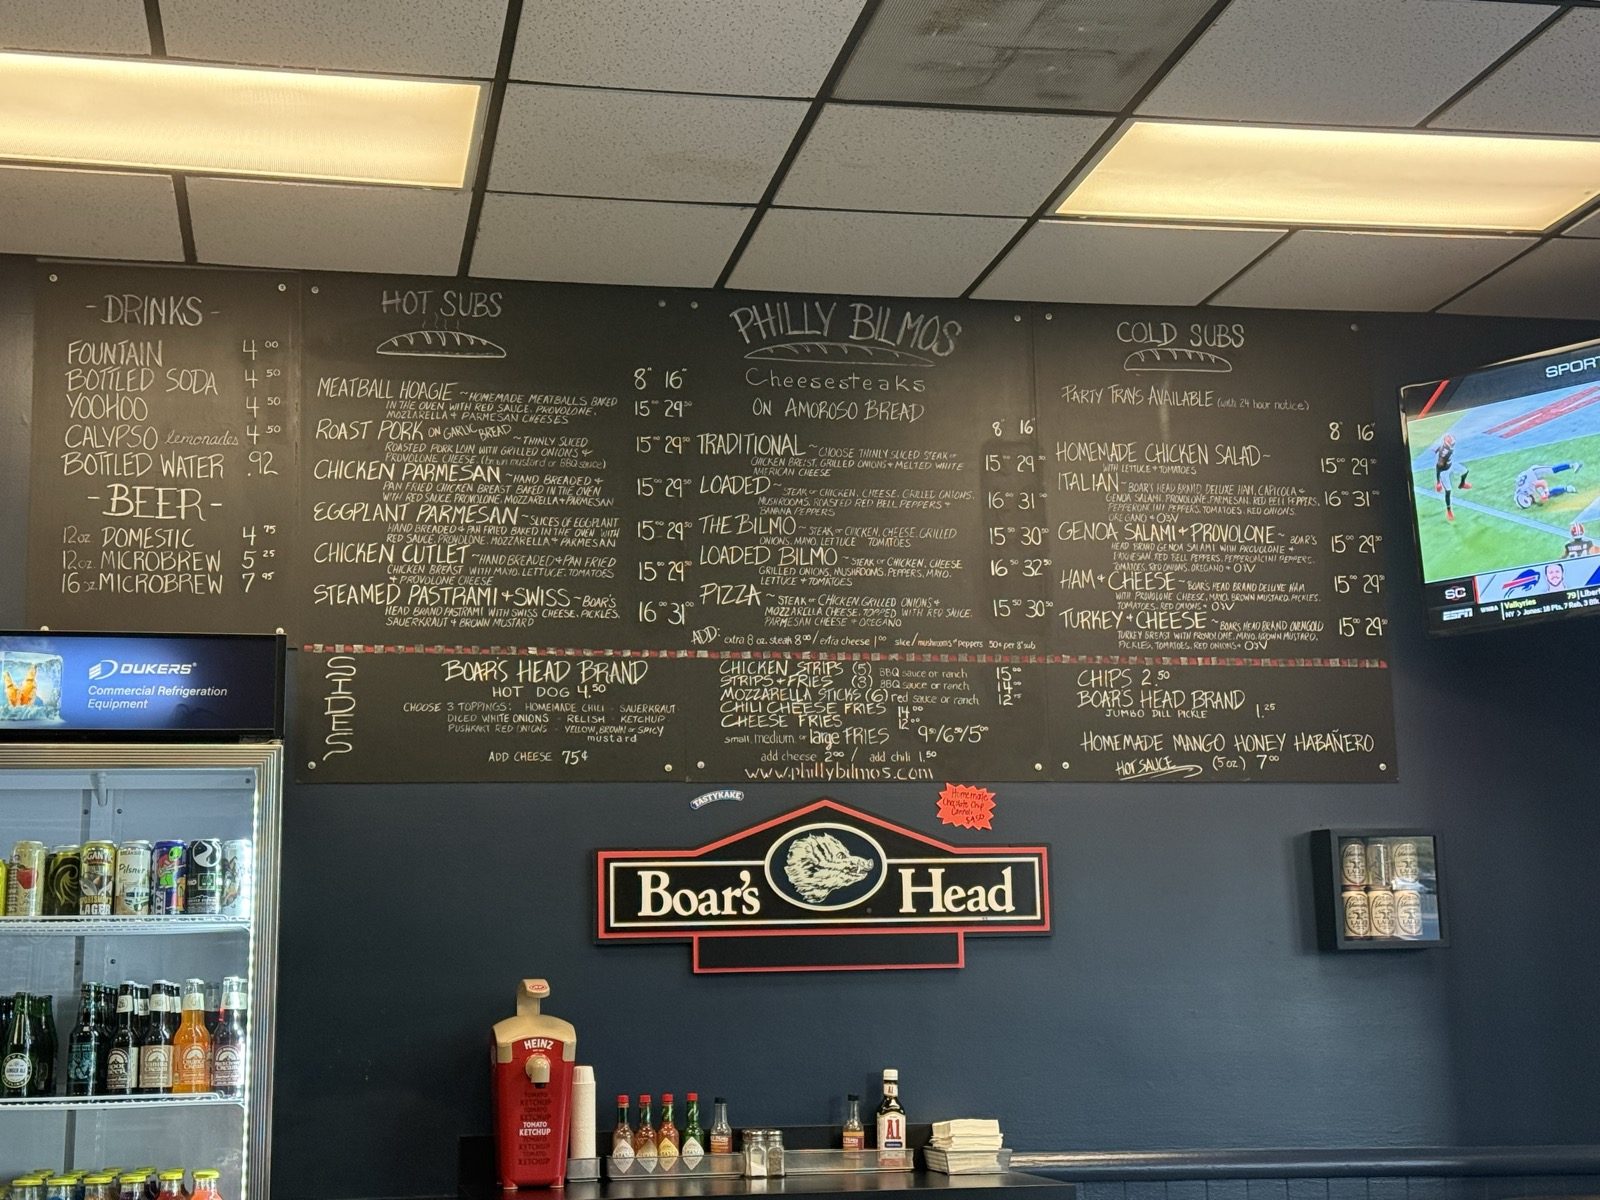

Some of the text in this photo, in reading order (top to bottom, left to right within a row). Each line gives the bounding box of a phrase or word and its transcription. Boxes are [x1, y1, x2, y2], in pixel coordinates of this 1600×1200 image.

[381, 290, 502, 318] HOT SUBS
[729, 301, 962, 357] PHILLY BILMOS
[1116, 321, 1245, 348] COLD SUBS
[67, 339, 162, 368] FOUNTAIN
[64, 367, 219, 396] BOTTLED SODA
[745, 367, 927, 393] Cheesesteaks
[317, 376, 588, 407] MEATBALL HOAGIE HOMEMADE MEATBALLS
[1061, 383, 1103, 406] PARTY
[1107, 385, 1144, 406] TRAYS
[1147, 385, 1214, 408] AVAILABLE
[1239, 399, 1250, 408] 24
[1251, 399, 1271, 410] hour
[1273, 399, 1311, 411] notice)
[66, 392, 148, 421] YOOHOO
[752, 397, 926, 423] ON AMOROSO BREAD
[64, 424, 159, 451] CALYPSO
[315, 418, 512, 442] ROAST PORK GARLIC BREAD
[523, 436, 588, 448] THINLY SLICED
[696, 432, 921, 460] TRADITIONAL CHOOSE SLICED
[61, 451, 153, 477] BOTTLED
[160, 450, 225, 479] WATER
[1055, 441, 1262, 466] HOMEMADE CHICKEN SALAD
[313, 459, 591, 486] CHICKEN PARMESAN HAND BREADED
[1057, 471, 1119, 493] ITALIAN
[699, 475, 771, 496] LOADED
[313, 501, 620, 528] EGGPLANT PARMESAN SLICES EGGPLANT
[698, 513, 796, 536] THE BILMO
[101, 526, 195, 549] DOMESTIC
[1057, 520, 1276, 544] GENOA SALAMI PROVOLONE
[100, 549, 221, 573] MICROBREW
[313, 542, 471, 564] CHICKEN CUTLET
[699, 545, 839, 567] LOADED BILMO
[98, 573, 223, 595] MICROBREW
[1059, 570, 1176, 591] HAM CHEESE
[313, 583, 401, 607] STEAMED
[407, 585, 498, 607] PASTRAMI
[513, 586, 571, 607] SWISS
[699, 582, 806, 607] PIZZA STEAK
[1444, 586, 1466, 600] SC
[385, 617, 448, 628] SAUERKRAUT
[1058, 607, 1208, 630] TURKEY CHEESE
[1442, 607, 1473, 621] ESPN
[119, 663, 193, 675] DUKERS
[441, 656, 648, 685] BOAR'S HEAD BRAND
[719, 660, 968, 680] CHICKEN STRIPS (5) sauce ranch
[1077, 668, 1133, 689] CHIPS
[87, 685, 228, 698] Commercial Refrigeration
[492, 685, 570, 698] HOT DOG
[720, 675, 874, 689] STRIPS FRIES (3)
[87, 699, 149, 711] Equipment
[720, 689, 938, 704] MOZZARELLA STICKS (6) red sauce
[1140, 689, 1186, 709] HEAD
[1191, 689, 1246, 710] BRAND
[322, 656, 357, 761] SIDES
[403, 702, 676, 715] CHOOSE TOPPINGS: HOMEMADE CHILI SAUERKRAUT
[447, 714, 665, 725] DICED WHITE ONIONS RELISH KETCHUP
[720, 702, 888, 716] CHILI CHEESE FRIES
[1105, 709, 1209, 719] JUMBO DILL PICKLE
[720, 714, 843, 729] CHEESE FRIES
[587, 734, 638, 743] mustard
[809, 730, 840, 751] large
[843, 727, 890, 745] FRIES
[1080, 731, 1164, 753] HOMEMADE
[1173, 732, 1226, 753] MANGO
[1233, 733, 1286, 753] HONEY
[488, 751, 510, 762] ADD
[513, 751, 553, 762] CHEESE
[1116, 756, 1176, 777] HOT SAUCE
[744, 762, 934, 782] www.phillybilmos.com
[692, 791, 742, 807] TASTYKAKE
[119, 863, 146, 875] Pilsner
[637, 866, 1016, 917] Boar's Head
[79, 903, 112, 916] LAGER
[523, 1038, 554, 1051] HEINZ
[519, 1128, 552, 1137] KETCHUP
[523, 1121, 548, 1129] TOMATO
